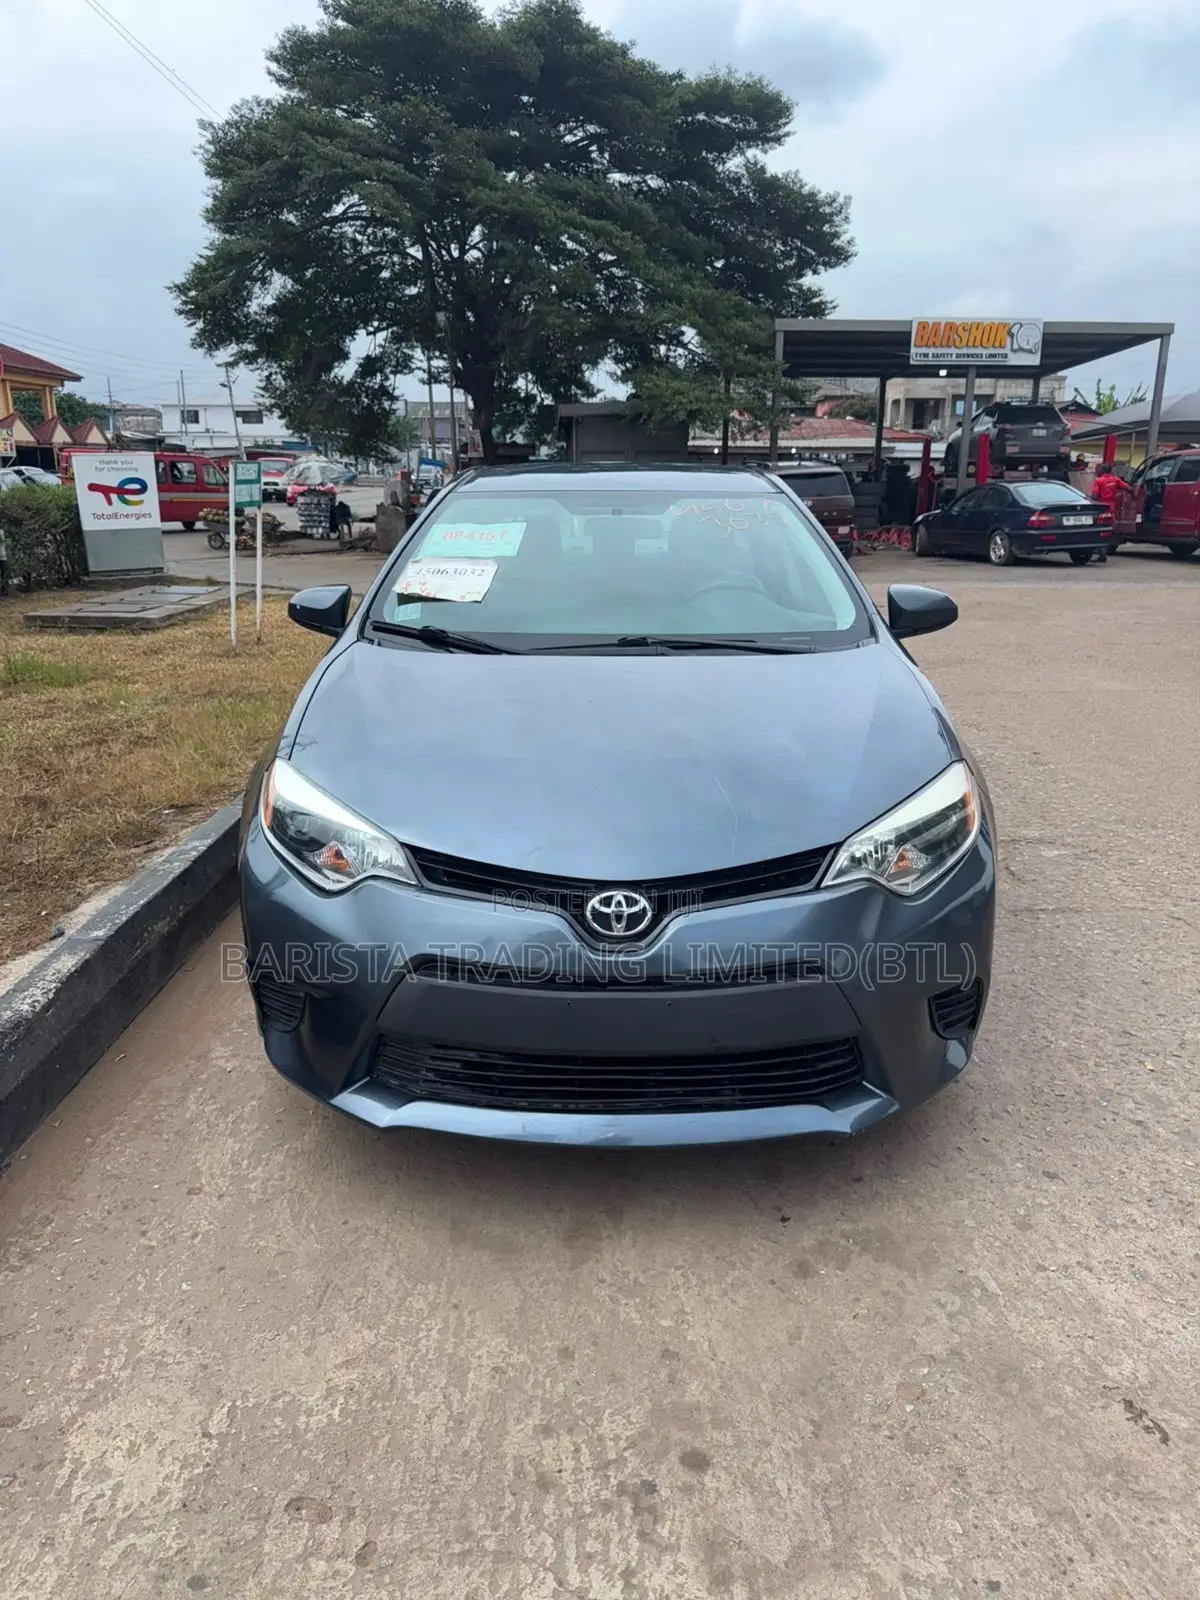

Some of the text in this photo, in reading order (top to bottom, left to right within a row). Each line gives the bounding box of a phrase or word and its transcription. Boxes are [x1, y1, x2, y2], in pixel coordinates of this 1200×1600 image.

[913, 320, 1010, 349] BARSHOK
[985, 352, 1009, 360] LIMITED
[91, 511, 152, 521] TotalEnergies
